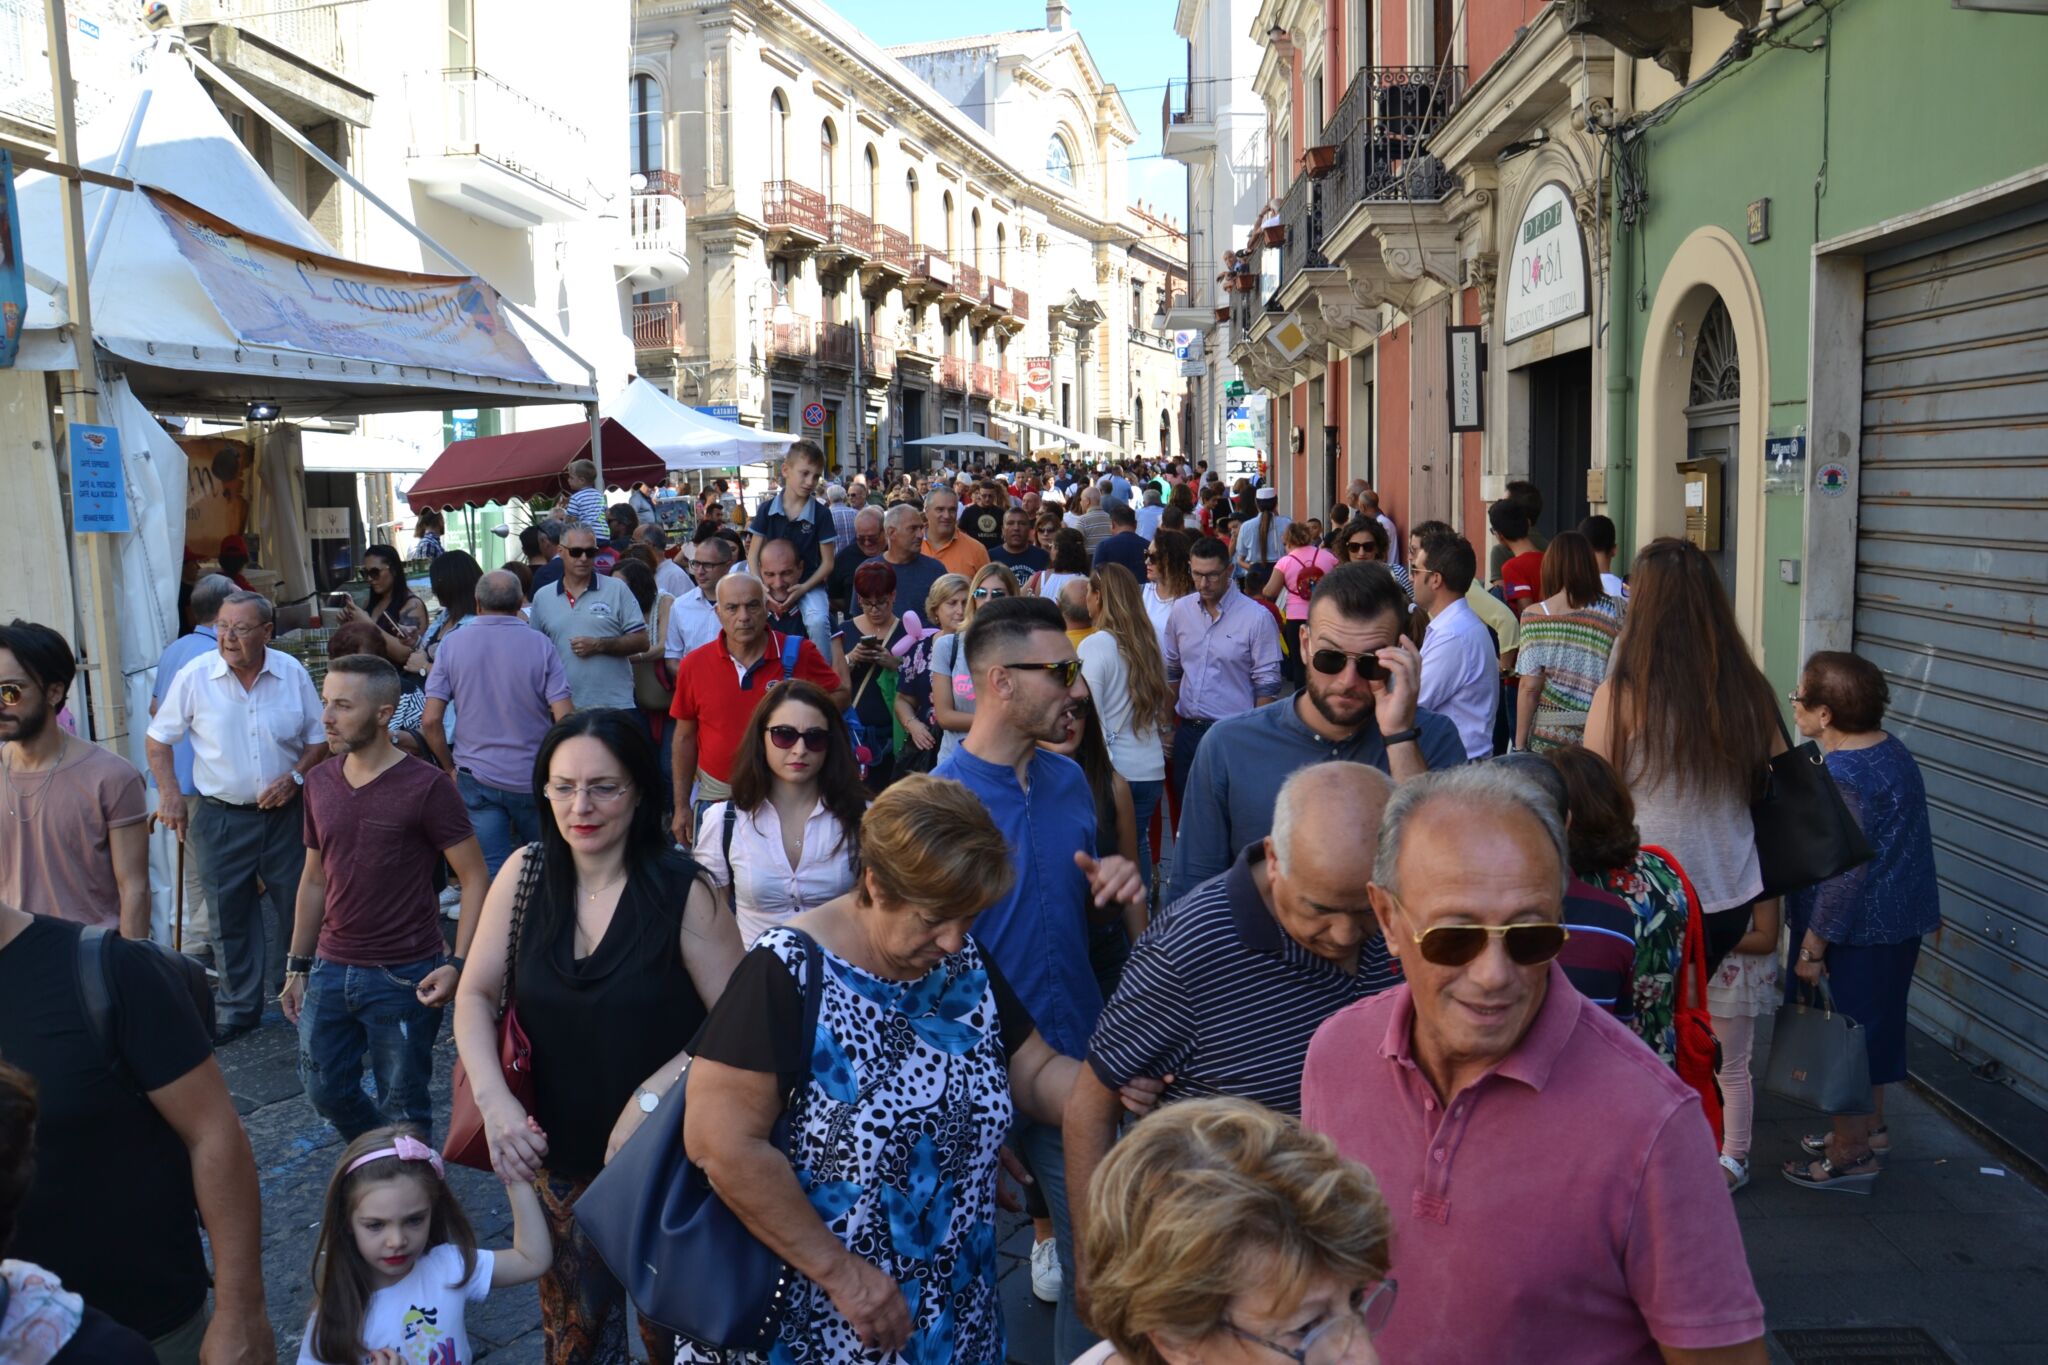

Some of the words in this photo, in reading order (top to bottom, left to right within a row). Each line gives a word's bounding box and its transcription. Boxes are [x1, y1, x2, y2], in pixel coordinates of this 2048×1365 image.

[1524, 203, 1562, 242] PEPE
[1460, 336, 1470, 422] RISTORANTE
[712, 407, 737, 415] CATANIA
[1771, 443, 1791, 456] Allianz
